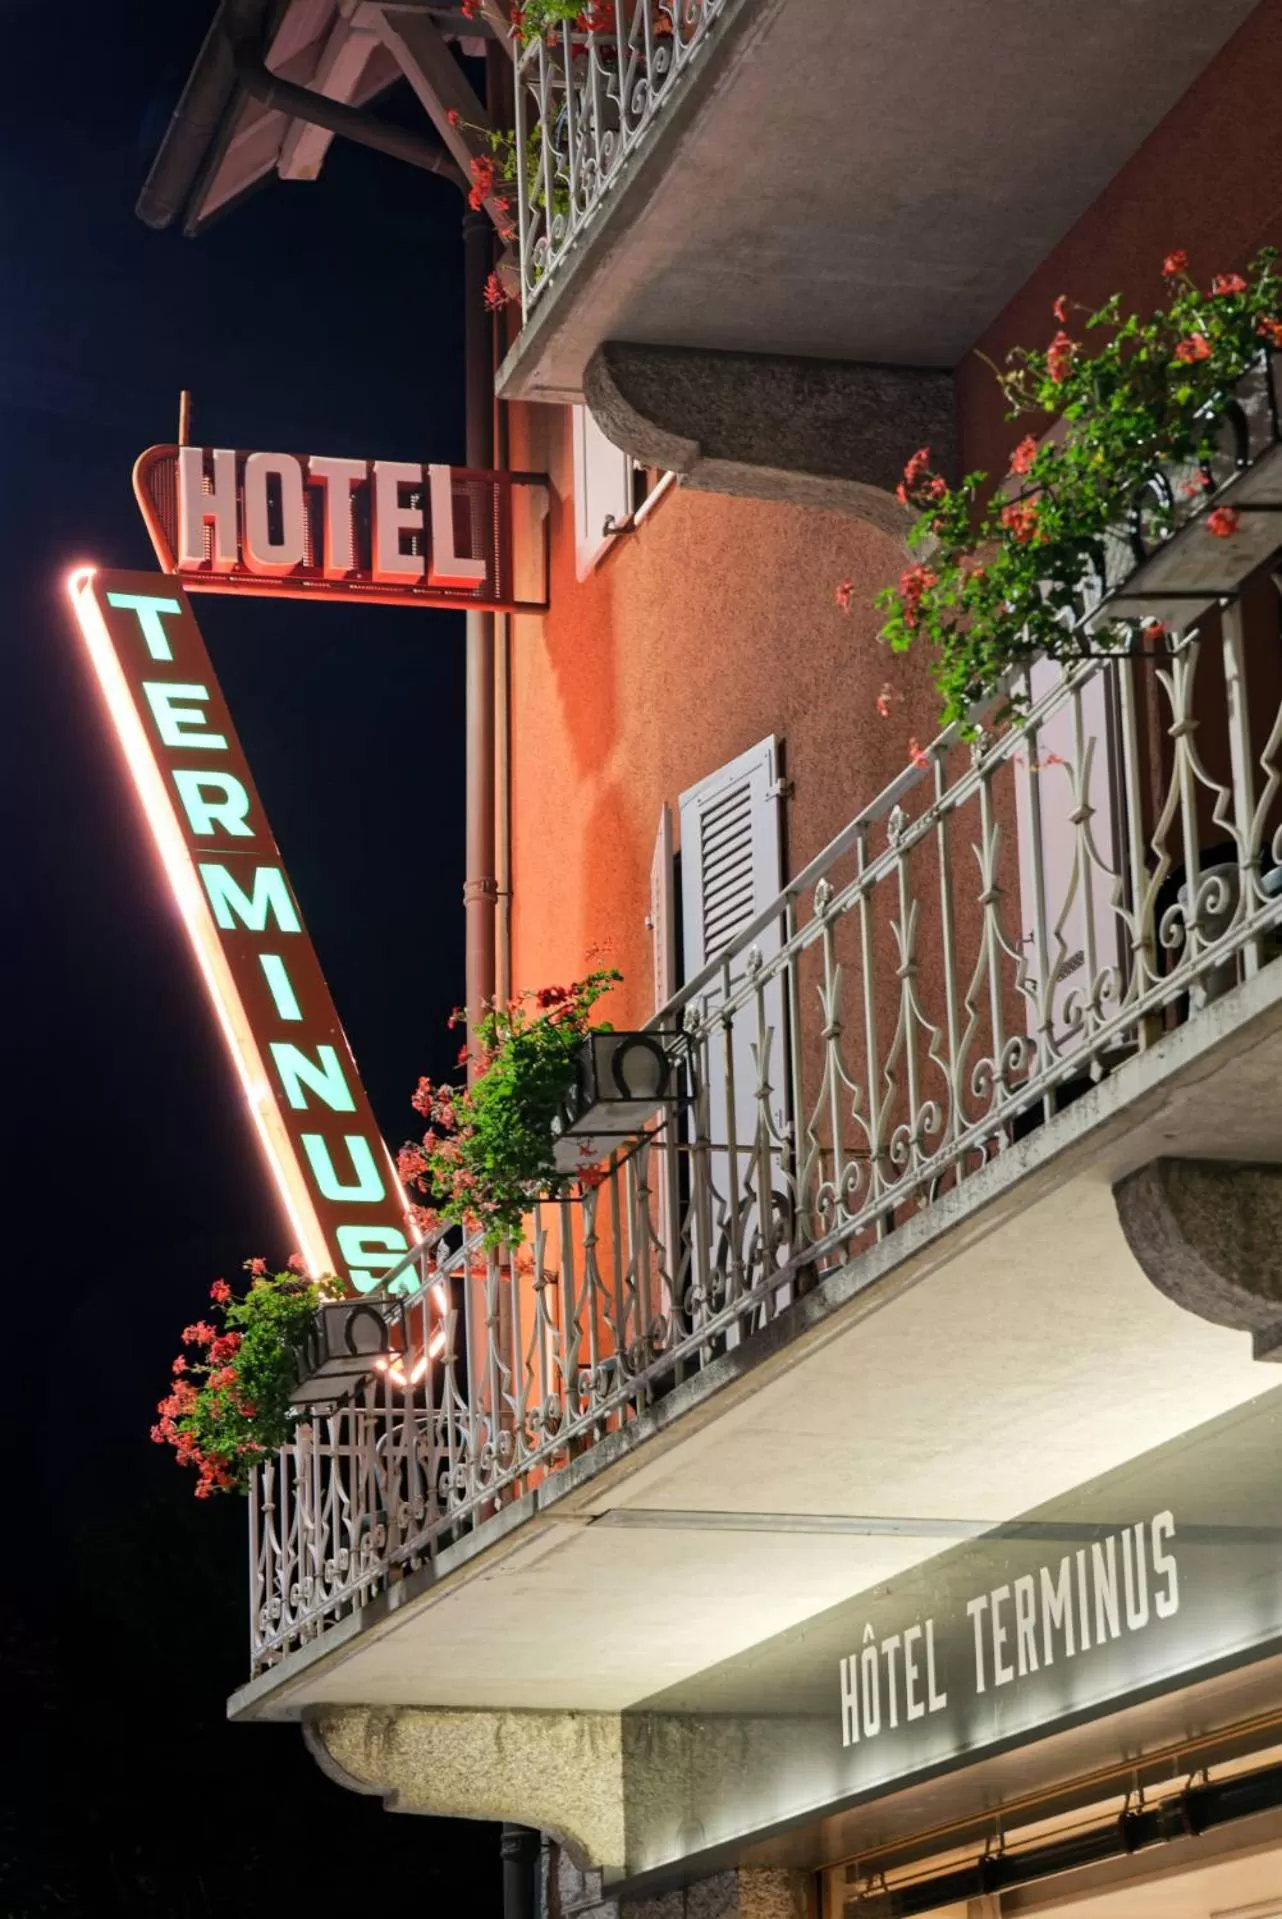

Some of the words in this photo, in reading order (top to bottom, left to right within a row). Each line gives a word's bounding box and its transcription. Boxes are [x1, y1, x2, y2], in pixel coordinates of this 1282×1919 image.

[177, 446, 487, 585] HOTEL
[106, 591, 422, 1296] TERMINUS
[839, 1618, 947, 1747] HÔTEL
[966, 1510, 1180, 1694] TERMINUS
